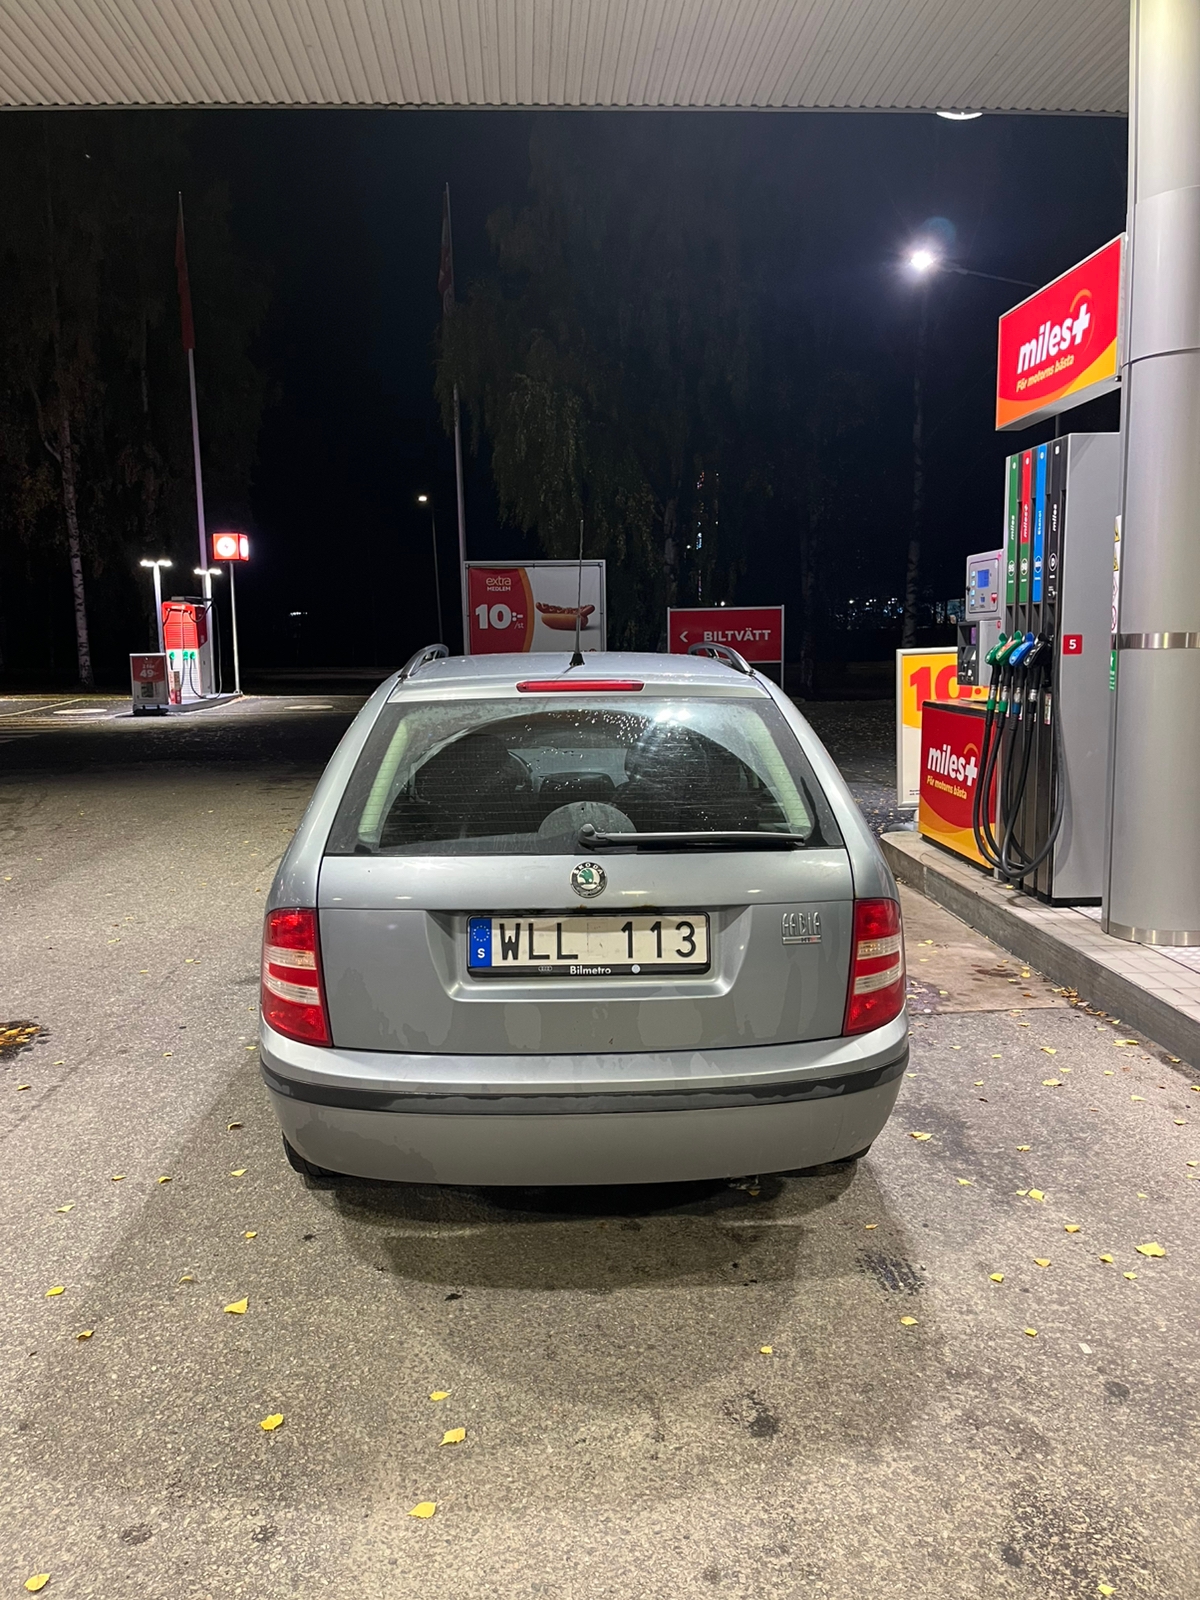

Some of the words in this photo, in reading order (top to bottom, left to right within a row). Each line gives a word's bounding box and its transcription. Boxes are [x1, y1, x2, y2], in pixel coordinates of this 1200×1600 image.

[1016, 377, 1028, 392] För
[1027, 366, 1055, 387] motorns
[1054, 355, 1074, 373] bästa
[486, 576, 512, 586] extra
[704, 627, 772, 642] BILTVÄTT
[1068, 639, 1077, 650] 5
[927, 775, 935, 786] För
[935, 780, 954, 795] motorns
[954, 785, 967, 799] bästa
[499, 922, 578, 961] WLL
[620, 921, 697, 959] 113
[477, 948, 486, 960] S
[570, 965, 612, 976] Bilmetro
